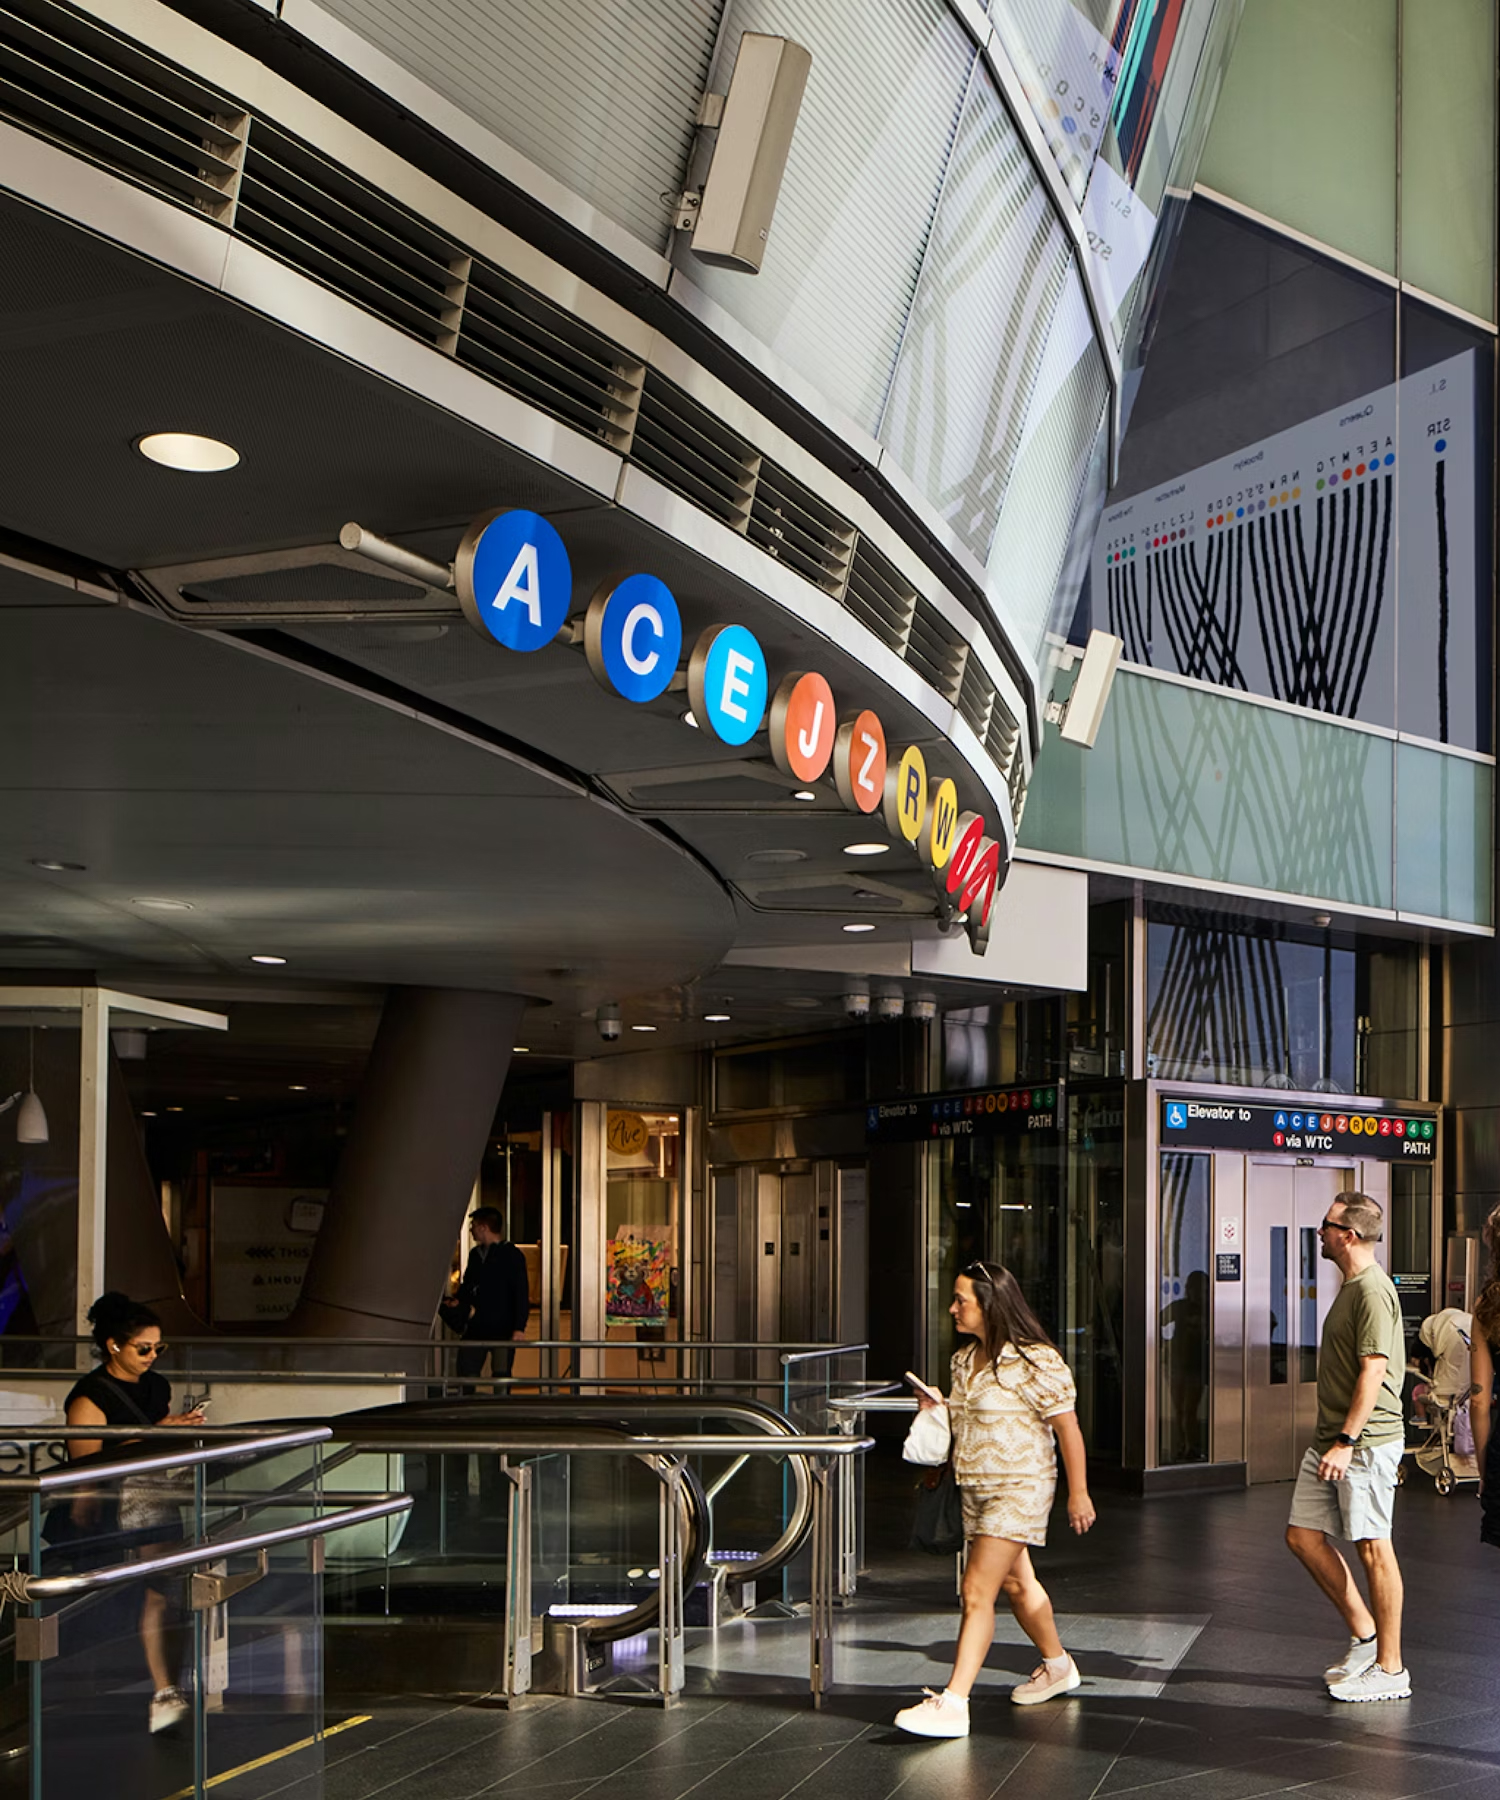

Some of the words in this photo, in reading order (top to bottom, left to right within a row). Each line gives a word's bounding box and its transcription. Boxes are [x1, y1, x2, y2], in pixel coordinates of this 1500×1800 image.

[490, 542, 542, 628] A
[620, 602, 664, 676] C
[718, 648, 756, 724] E
[798, 700, 824, 759] J
[857, 731, 879, 792] Z
[903, 764, 921, 823] R
[937, 794, 955, 850] W
[956, 837, 976, 876] 1
[878, 1105, 908, 1118] Elevator
[954, 1101, 961, 1111] E
[1010, 1096, 1017, 1107] 2
[1022, 1095, 1029, 1106] 3
[1034, 1094, 1041, 1105] 4
[1046, 1092, 1053, 1103] 5
[939, 1124, 951, 1136] via
[952, 1119, 974, 1135] WTC
[1027, 1113, 1052, 1129] PATH
[1187, 1104, 1235, 1120] Elevator
[1238, 1107, 1251, 1121] to
[1276, 1114, 1285, 1125] A
[1292, 1115, 1301, 1127] C
[1308, 1116, 1315, 1128] E
[1323, 1117, 1330, 1129] J
[1338, 1118, 1345, 1129] Z
[1353, 1119, 1360, 1131] R
[1366, 1120, 1376, 1131] W
[1382, 1122, 1389, 1132] 2
[1396, 1123, 1403, 1133] 3
[1410, 1124, 1416, 1134] 4
[1424, 1125, 1430, 1135] 5
[611, 1119, 641, 1148] Ave
[1285, 1134, 1301, 1148] via
[1304, 1135, 1333, 1149] WTC
[1403, 1141, 1431, 1155] PATH
[279, 1247, 310, 1258] THIS
